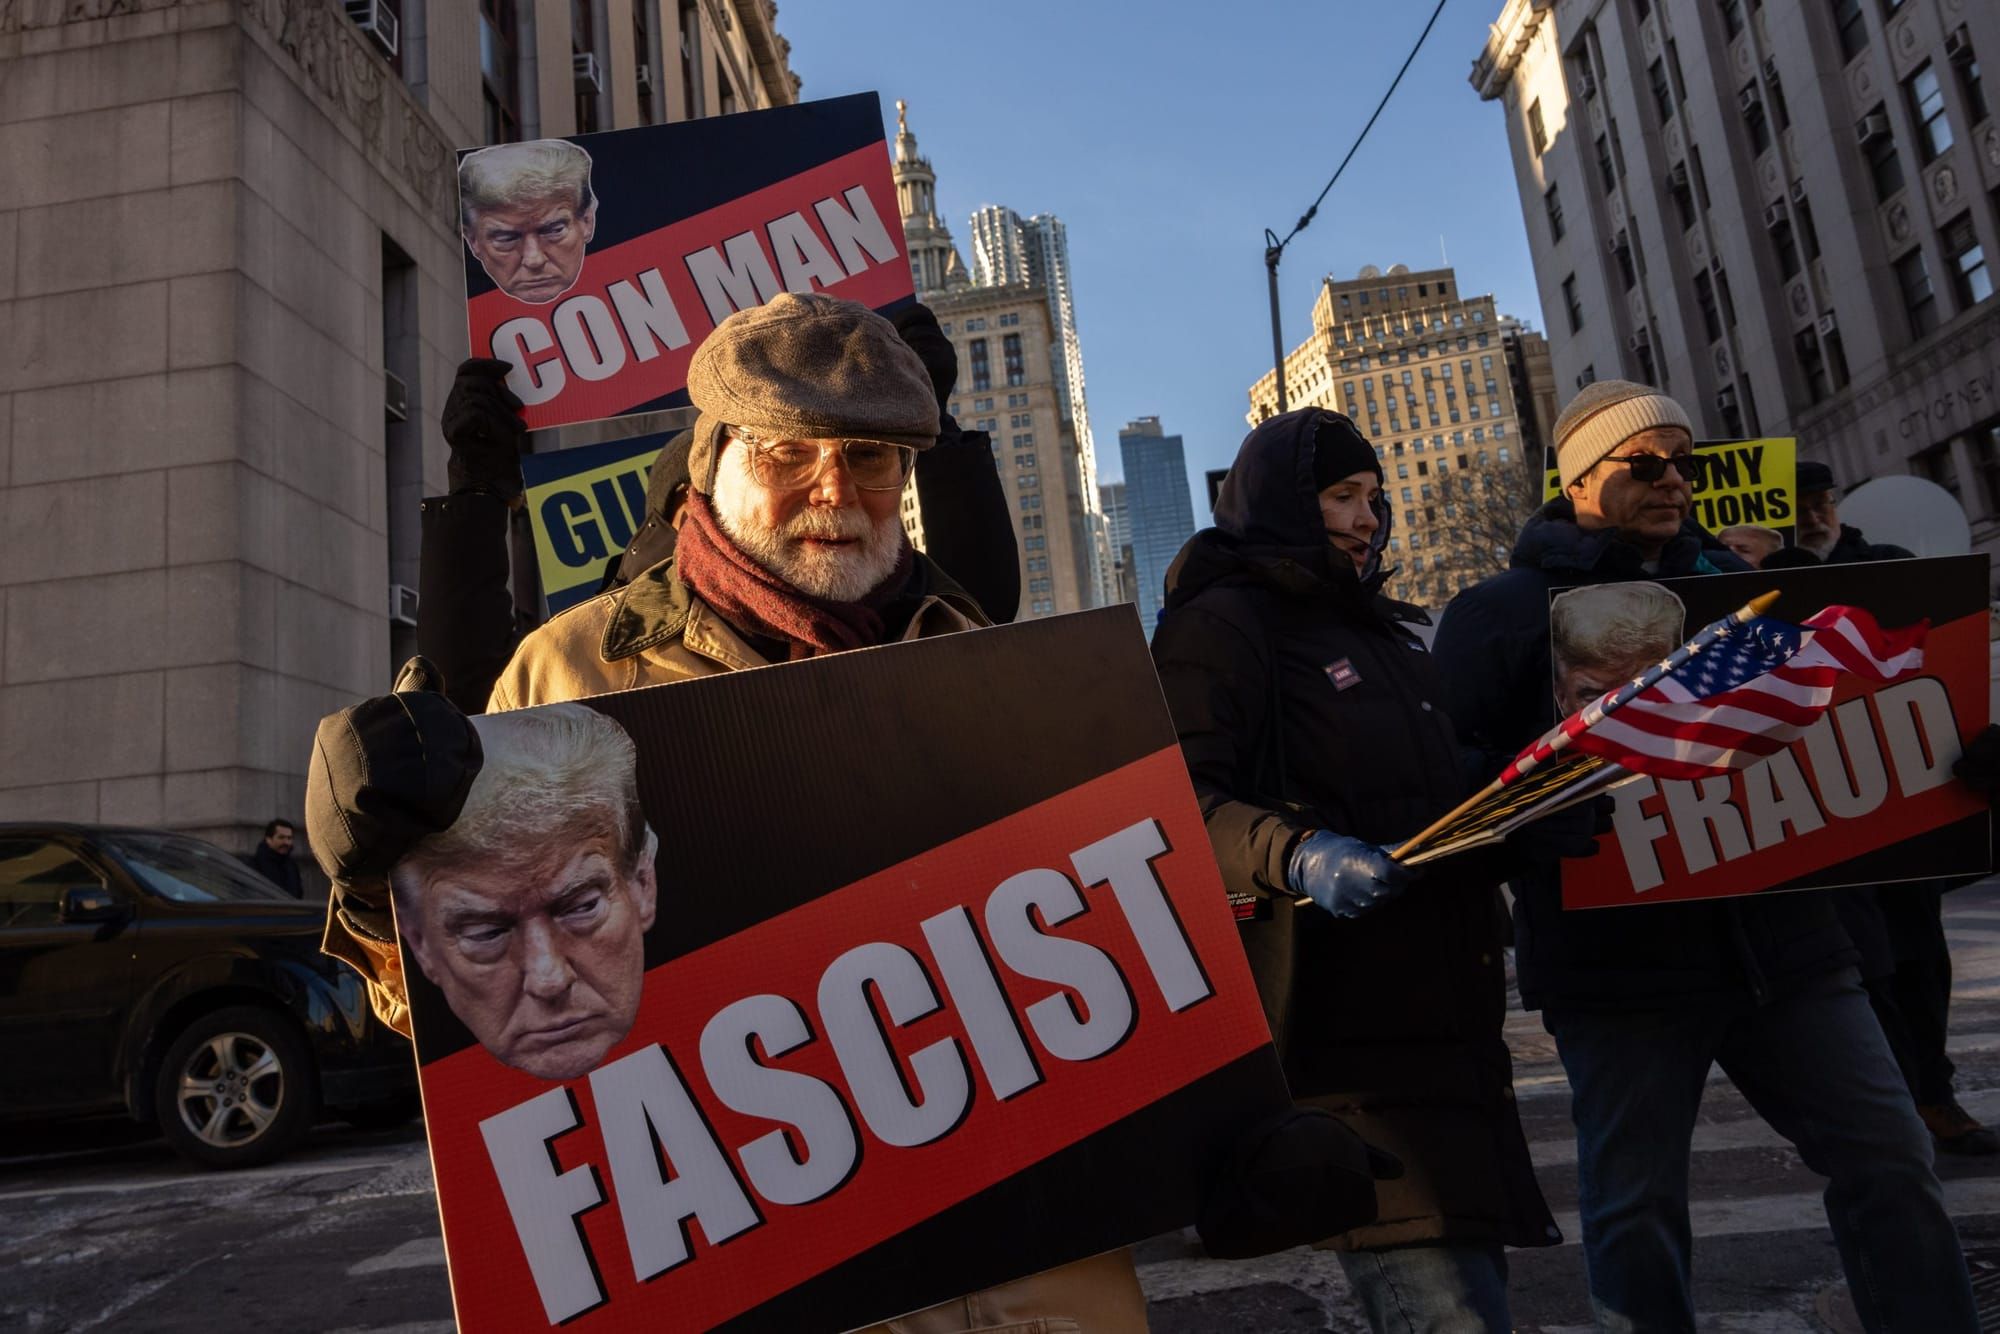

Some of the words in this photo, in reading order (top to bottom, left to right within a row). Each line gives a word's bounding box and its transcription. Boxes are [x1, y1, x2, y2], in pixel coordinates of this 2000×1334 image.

[490, 267, 691, 407] CON
[683, 184, 900, 326] MAN
[1934, 391, 1954, 421] OF
[541, 464, 654, 568] GU
[1607, 676, 1963, 894] FRAUD
[478, 817, 1212, 1326] FASCIST
